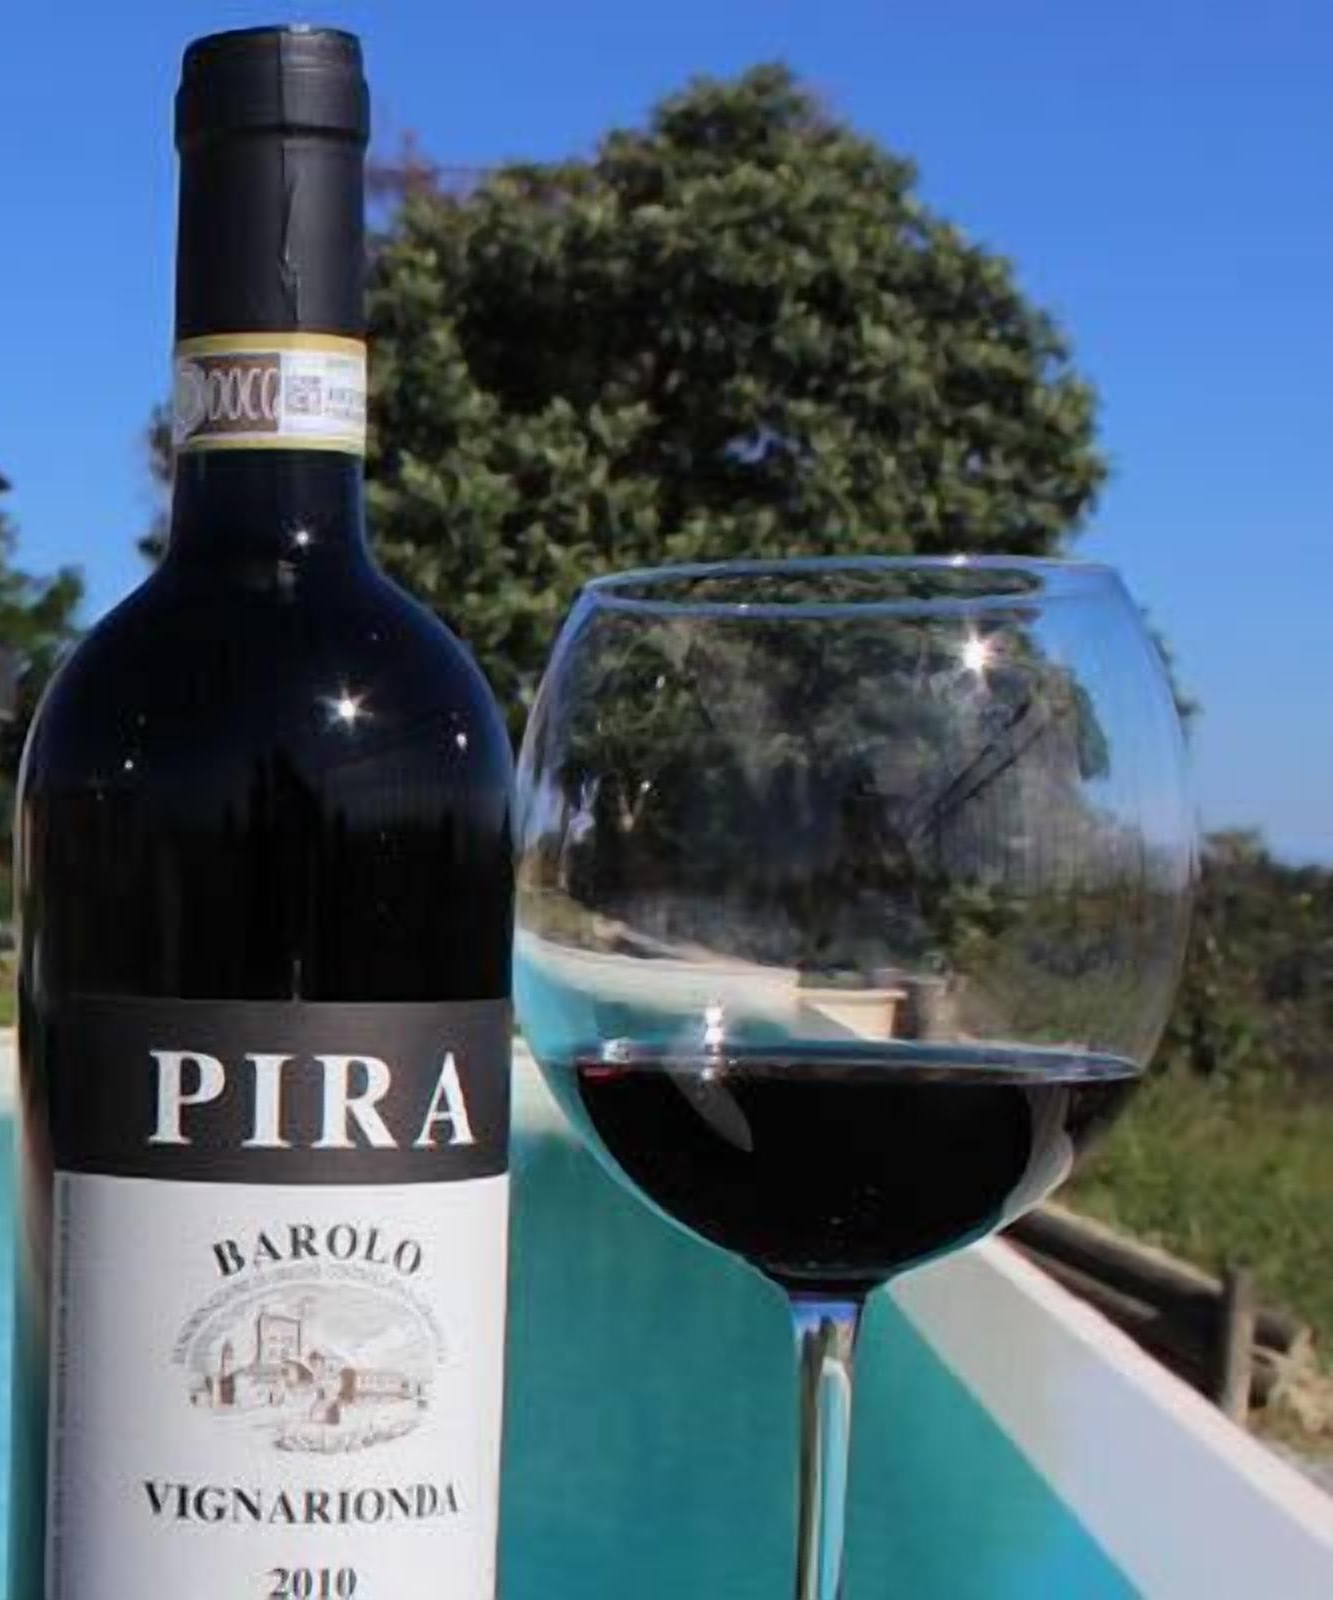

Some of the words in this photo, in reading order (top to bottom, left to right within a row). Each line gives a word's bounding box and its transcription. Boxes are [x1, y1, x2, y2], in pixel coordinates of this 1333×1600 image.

[148, 1050, 476, 1148] PIRA
[212, 1223, 421, 1277] BAROLO
[144, 1481, 460, 1525] VIGNARIONDA
[269, 1567, 357, 1600] 2010
